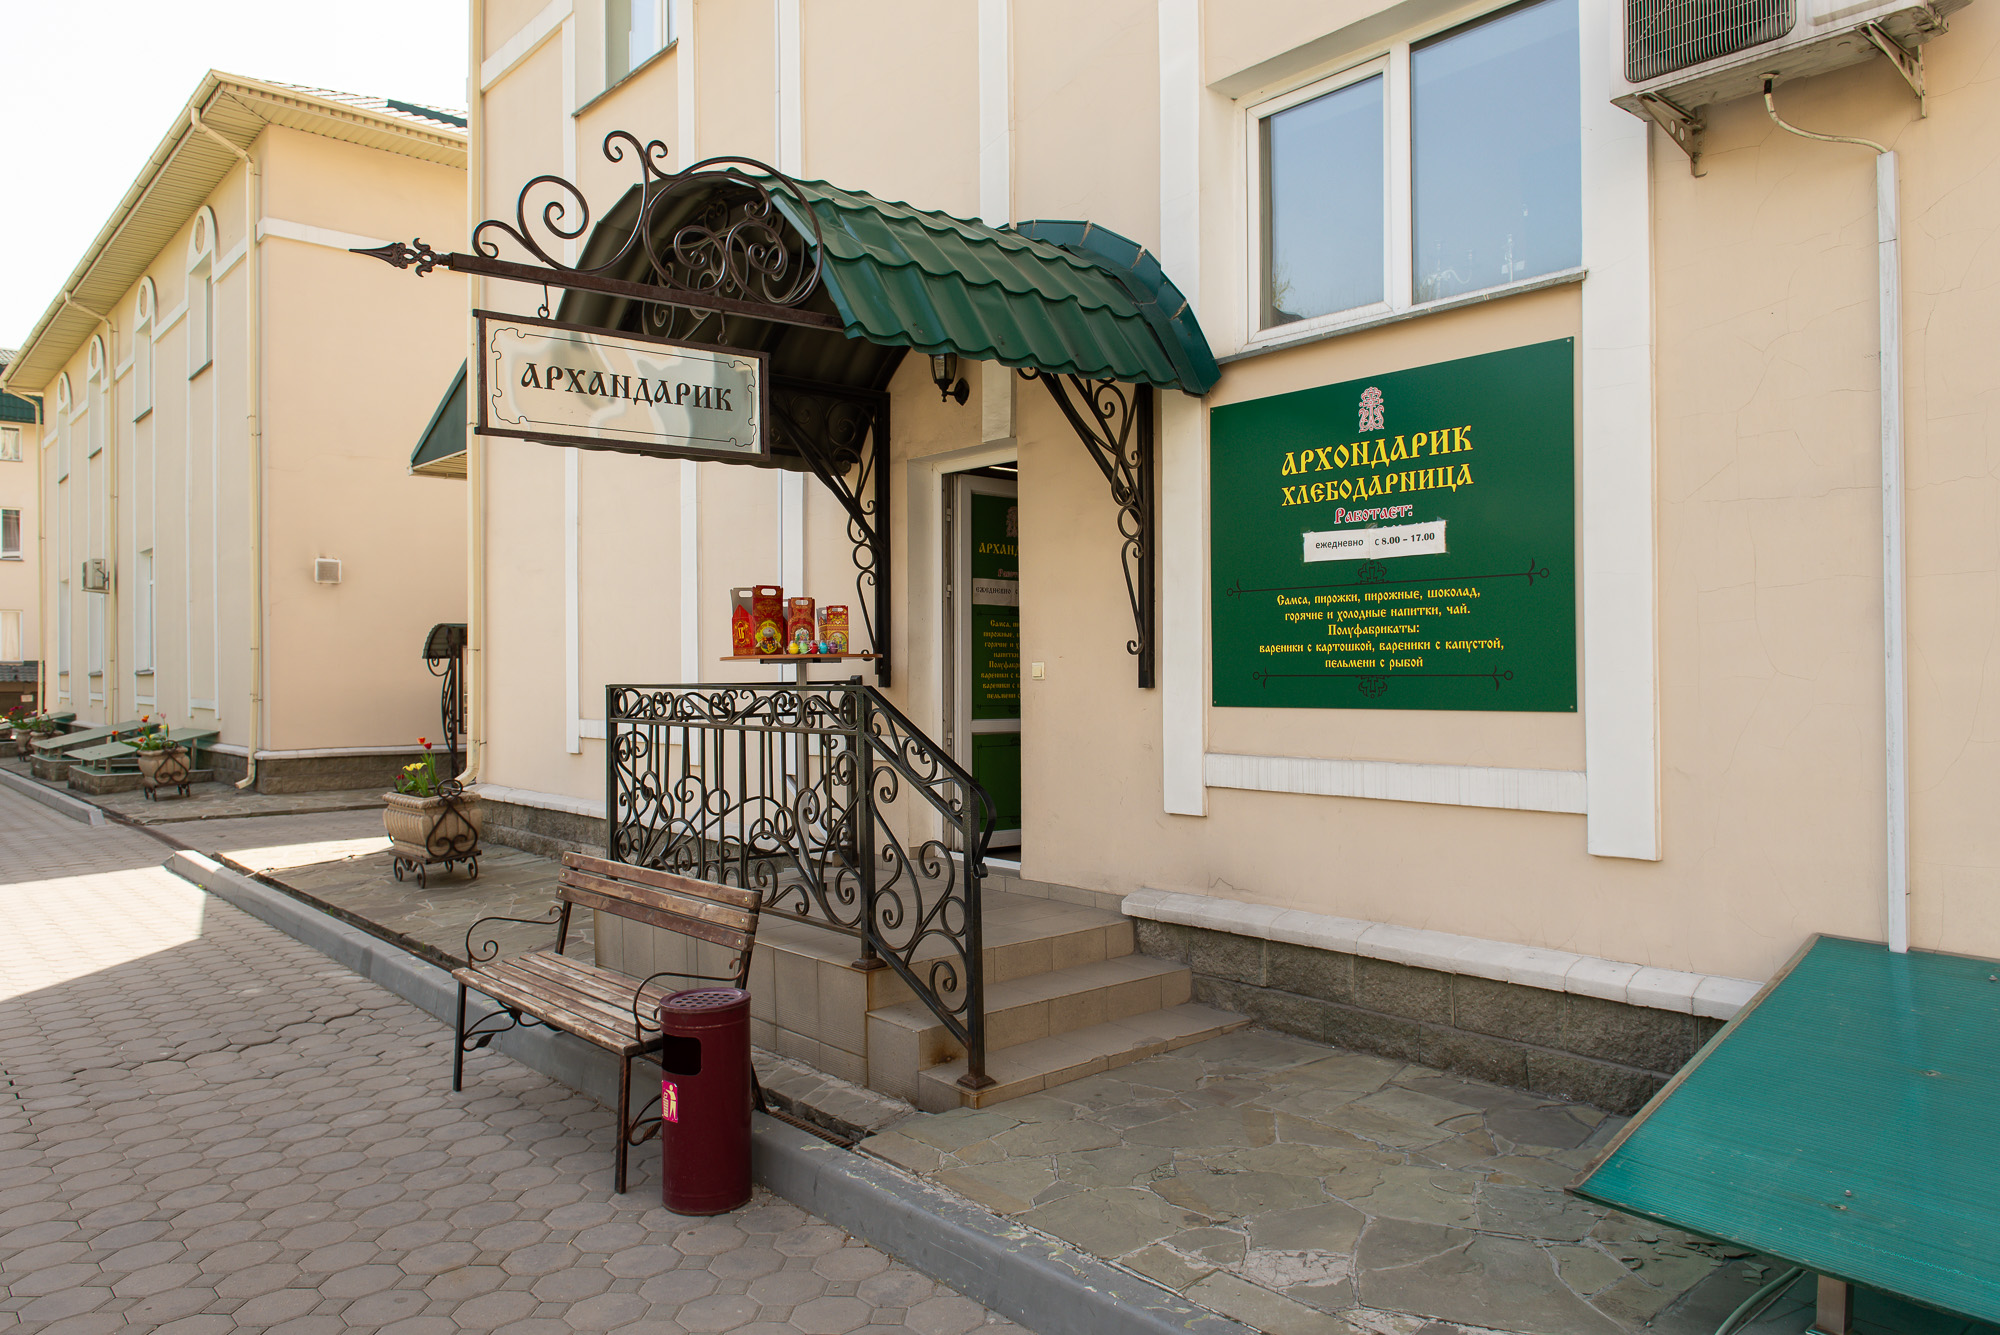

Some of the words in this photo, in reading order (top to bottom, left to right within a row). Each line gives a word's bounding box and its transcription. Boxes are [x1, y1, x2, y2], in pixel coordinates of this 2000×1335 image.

[520, 362, 734, 412] АРХАНДАРИК
[1281, 425, 1474, 476] АРХОНДАРИК
[1281, 463, 1475, 507] ХЛЕБОДАРНИЦА
[1333, 504, 1413, 524] Работает:
[1315, 538, 1364, 549] ежедневно
[1381, 535, 1401, 546] 8.00
[1410, 532, 1436, 543] 17.00
[1277, 594, 1311, 606] Самса,
[1314, 593, 1361, 606] пирожки,
[1364, 590, 1423, 604] пирожные,
[1427, 587, 1481, 599] шоколад,
[1284, 611, 1324, 624] горячие
[1327, 611, 1334, 619] и
[1336, 608, 1387, 622] холодные
[1390, 606, 1442, 617] напитки,
[1446, 603, 1471, 614] чай.
[1327, 624, 1420, 638] Полуфабрикаты:
[1259, 643, 1304, 655] вареники
[1307, 643, 1312, 652] с
[1315, 640, 1375, 655] картошкой,
[1379, 641, 1431, 654] вареники
[1435, 641, 1441, 650] с
[1445, 637, 1504, 653] капустой,
[1325, 659, 1376, 668] пельмени
[1379, 658, 1385, 667] с
[1389, 656, 1424, 671] рыбой
